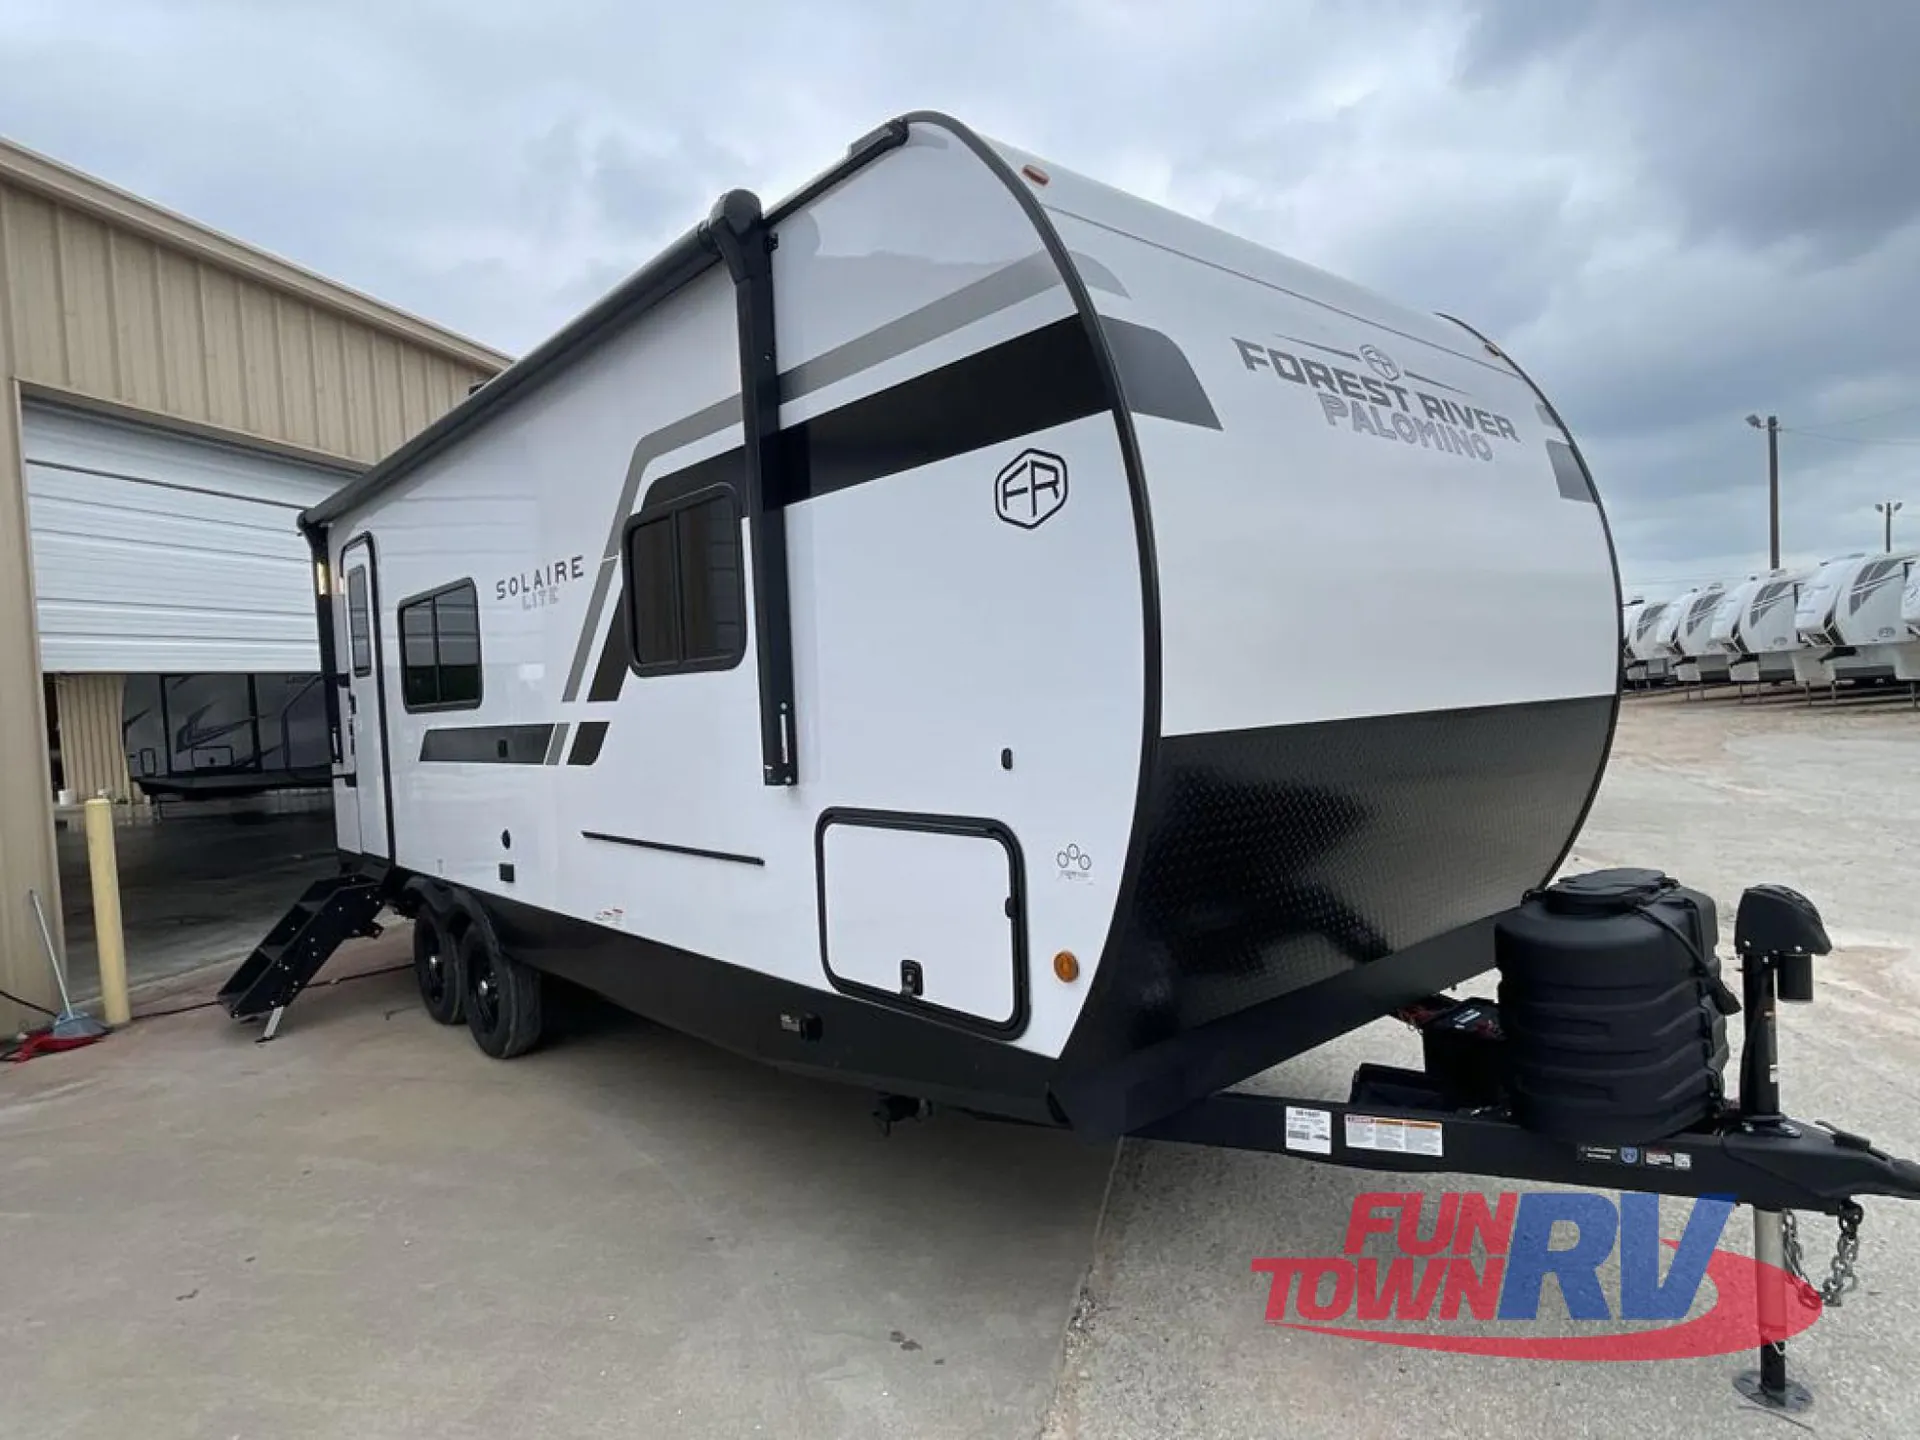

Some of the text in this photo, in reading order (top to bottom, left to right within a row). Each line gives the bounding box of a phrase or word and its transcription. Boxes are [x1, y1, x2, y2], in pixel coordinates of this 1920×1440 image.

[1231, 337, 1521, 443] FOREST RIVER
[1317, 392, 1494, 462] PALOMINO
[1002, 459, 1060, 517] FR
[496, 554, 585, 601] SOLAIRE
[521, 585, 560, 611] LITE
